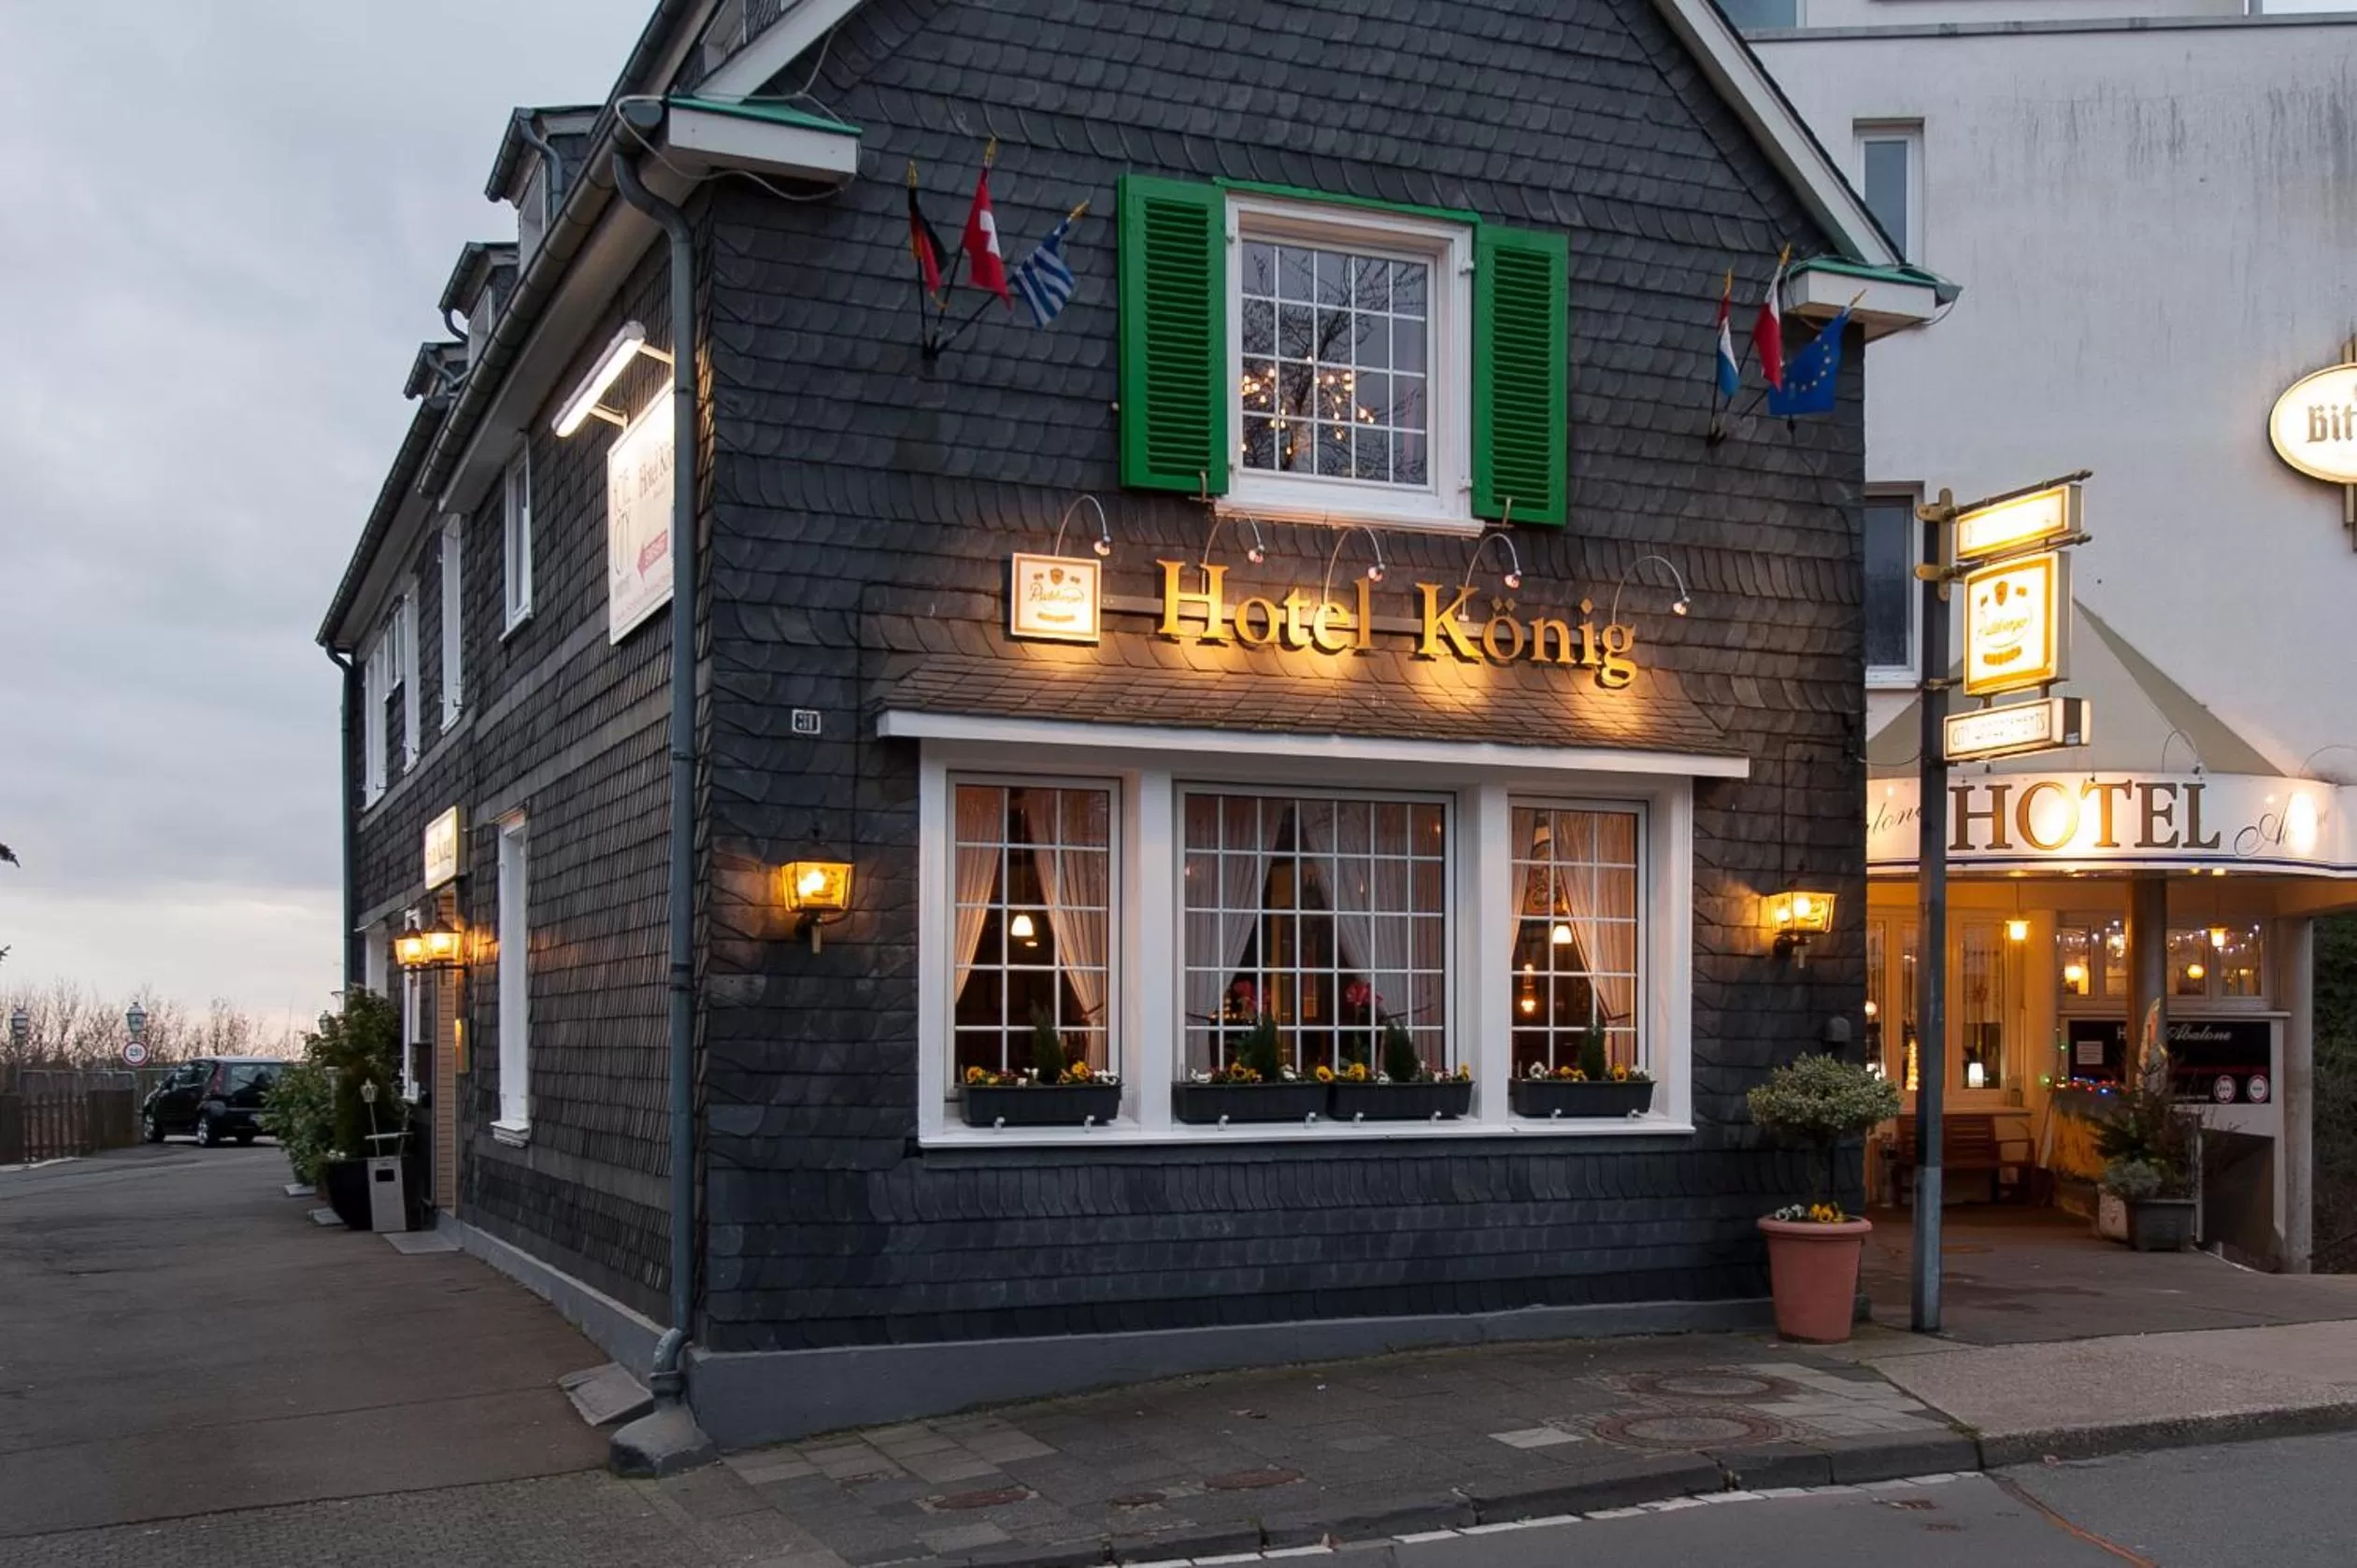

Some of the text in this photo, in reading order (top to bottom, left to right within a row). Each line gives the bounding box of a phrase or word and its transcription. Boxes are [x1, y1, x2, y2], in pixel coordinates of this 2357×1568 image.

[1156, 558, 1637, 687] Hotel König
[1949, 778, 2221, 850] HOTEL
